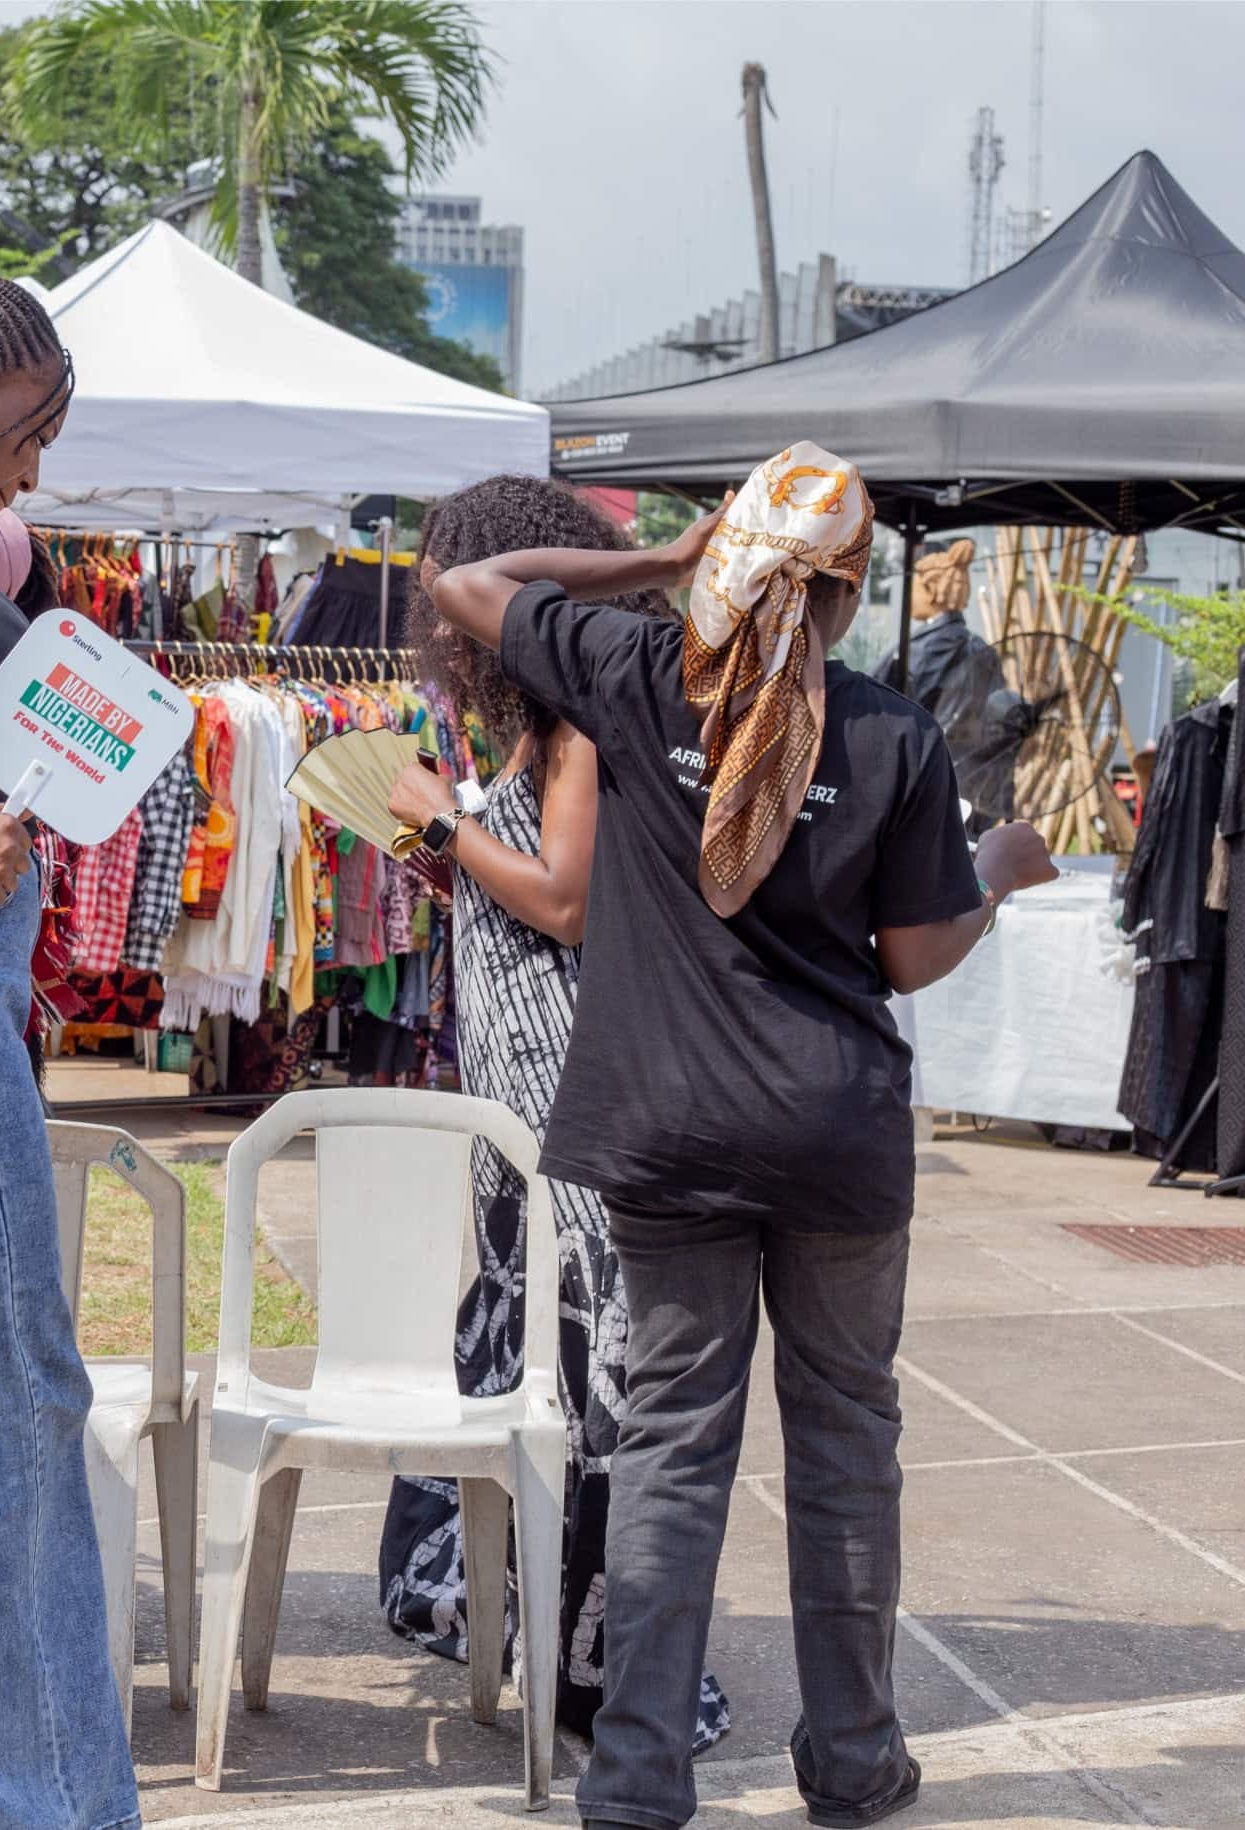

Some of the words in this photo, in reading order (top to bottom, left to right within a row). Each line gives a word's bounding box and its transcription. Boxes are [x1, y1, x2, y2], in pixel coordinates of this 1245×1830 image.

[72, 634, 103, 662] Sterling
[28, 684, 128, 770] NIGERIANS
[59, 672, 111, 721] MADE
[104, 706, 133, 736] BY
[668, 746, 706, 769] AFRI
